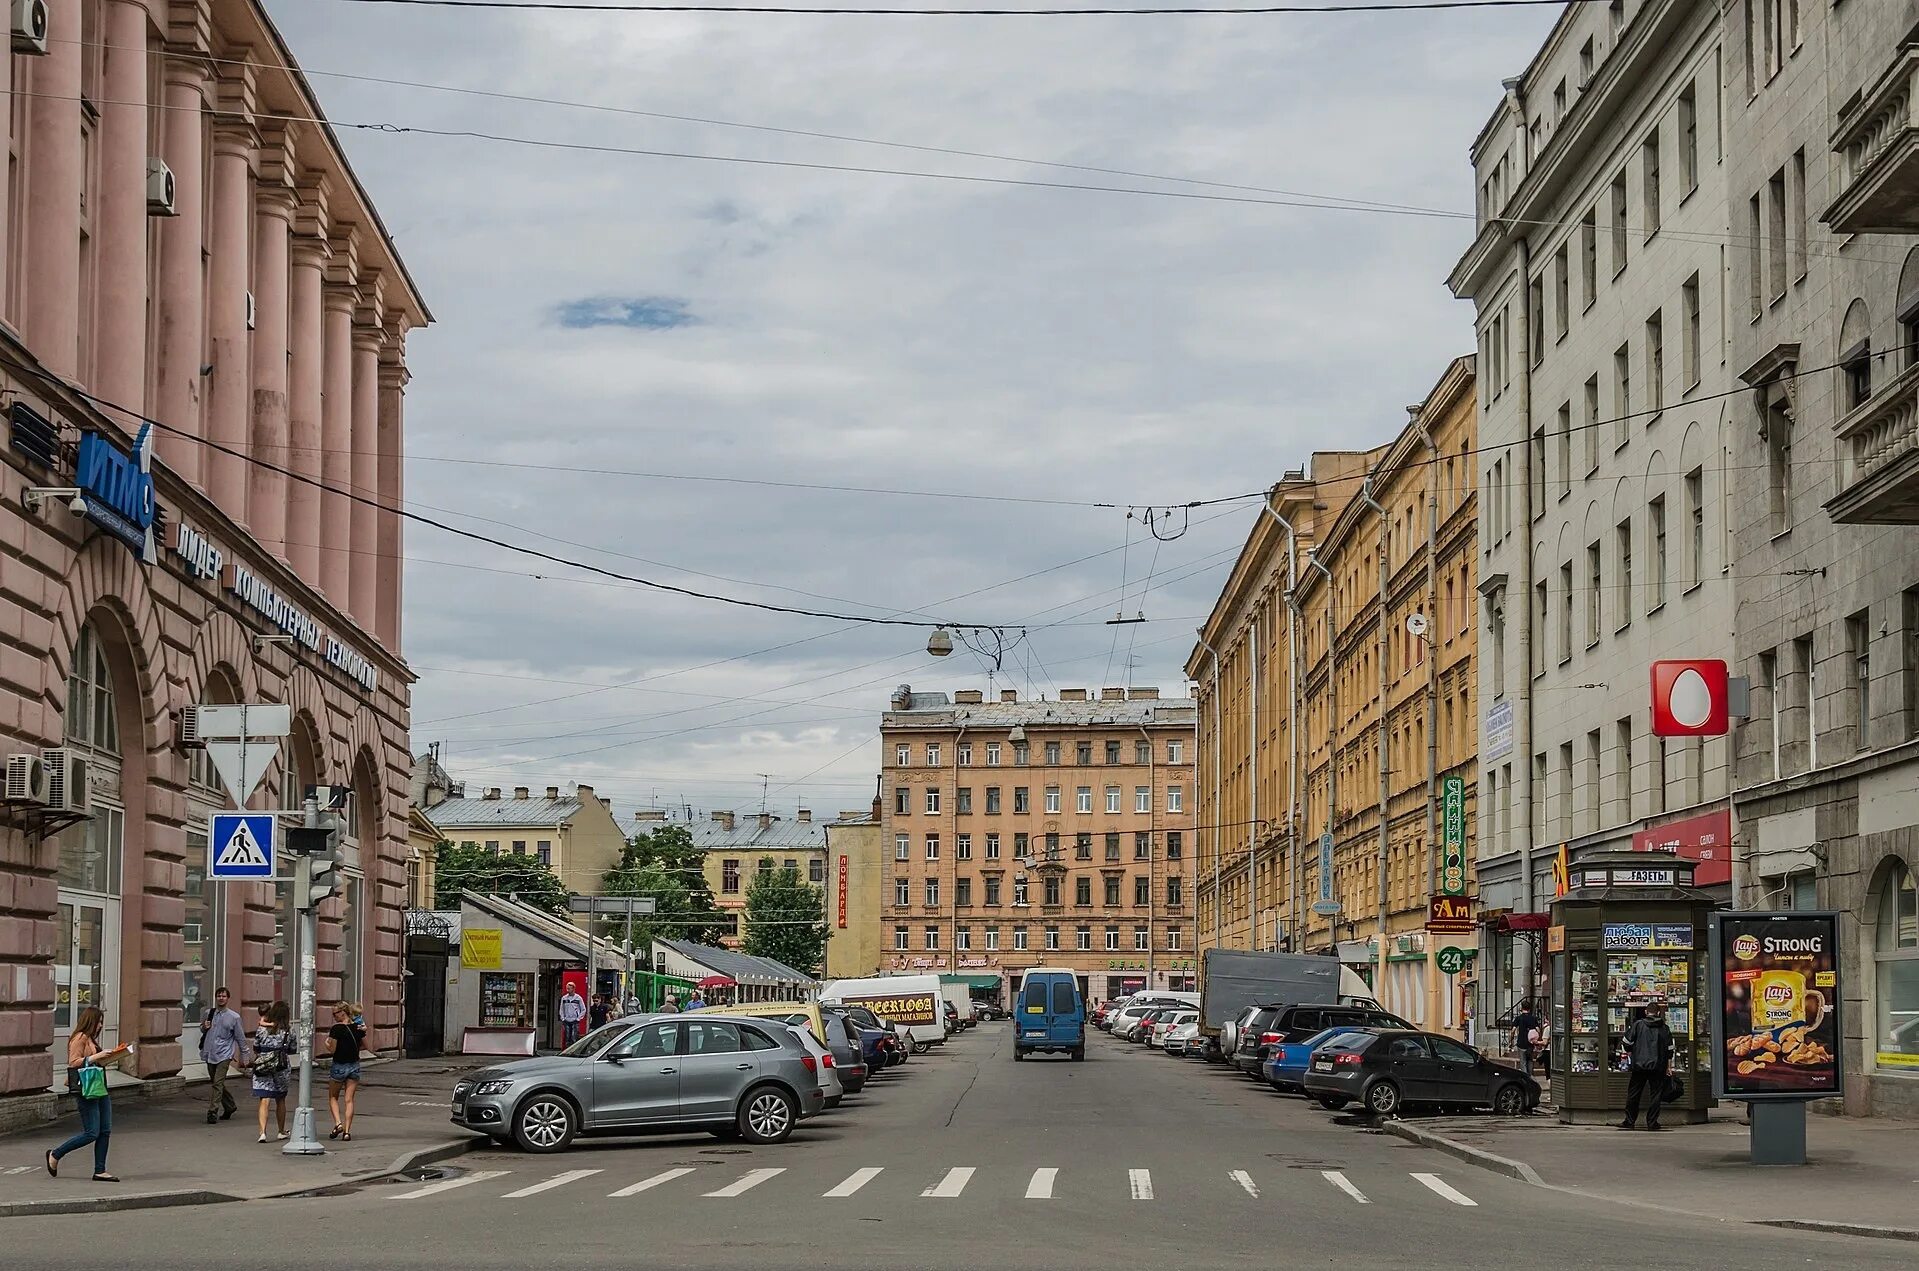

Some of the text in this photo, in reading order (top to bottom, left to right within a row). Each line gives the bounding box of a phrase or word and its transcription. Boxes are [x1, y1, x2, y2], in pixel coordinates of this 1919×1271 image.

[80, 431, 155, 529] ИТМО
[177, 523, 223, 580] ЛИДЕР
[235, 565, 322, 654] КОМПЬЮТЕРНЫХ
[1631, 871, 1668, 881] ГАЗЕТЫ
[1605, 924, 1651, 938] любая
[1604, 934, 1650, 948] работа
[1735, 936, 1822, 954] Lay's STRONG
[1109, 960, 1145, 968] SELA
[1441, 952, 1461, 970] 24
[1765, 986, 1792, 1002] Lay's
[1766, 1010, 1792, 1018] STRONG
